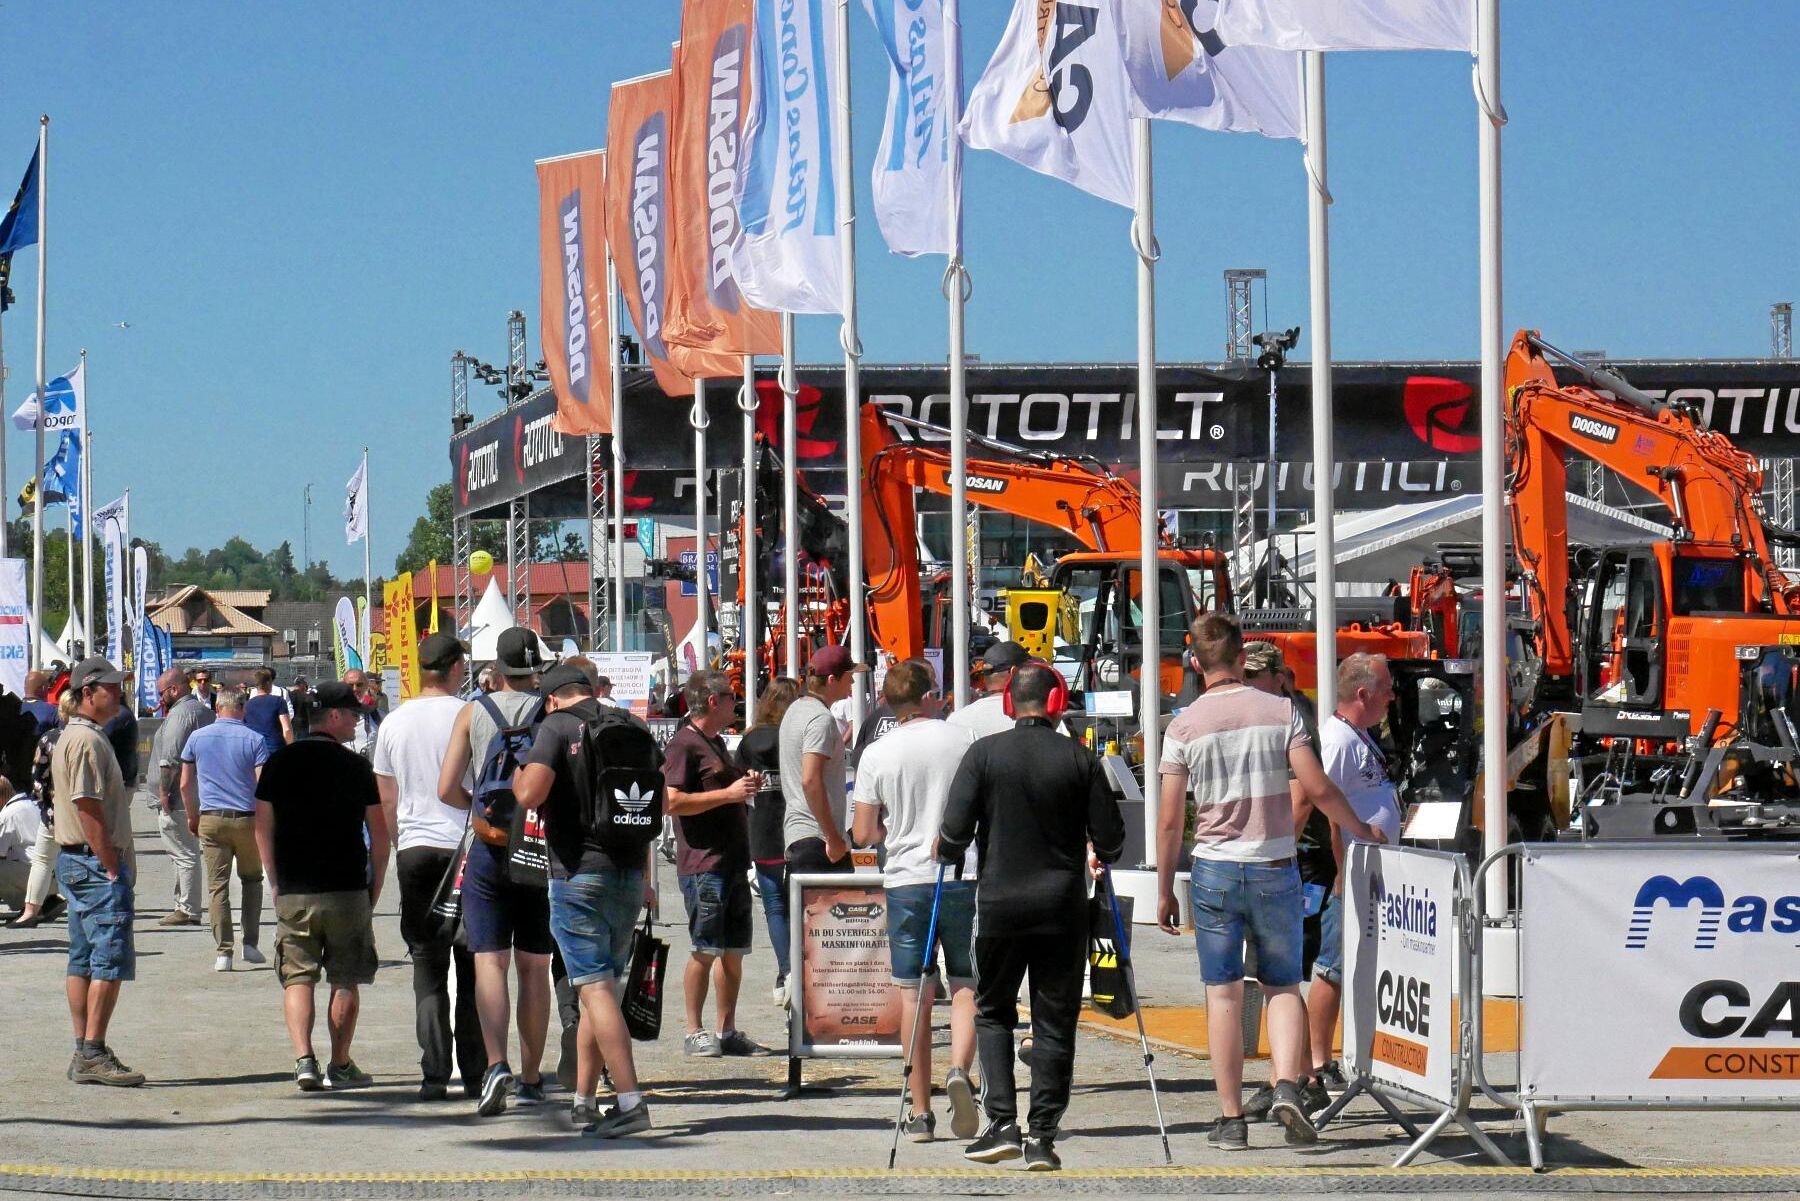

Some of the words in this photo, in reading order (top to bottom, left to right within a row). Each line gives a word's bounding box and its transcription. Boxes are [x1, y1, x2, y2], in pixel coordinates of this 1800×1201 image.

[1571, 416, 1617, 440] DOOSAN
[613, 813, 652, 825] adidas
[822, 928, 834, 937] DU
[836, 928, 877, 937] SVERIGES
[1377, 969, 1431, 1037] CASE
[841, 1016, 878, 1025] CASE
[1381, 1038, 1427, 1070] CONSTRUCTION
